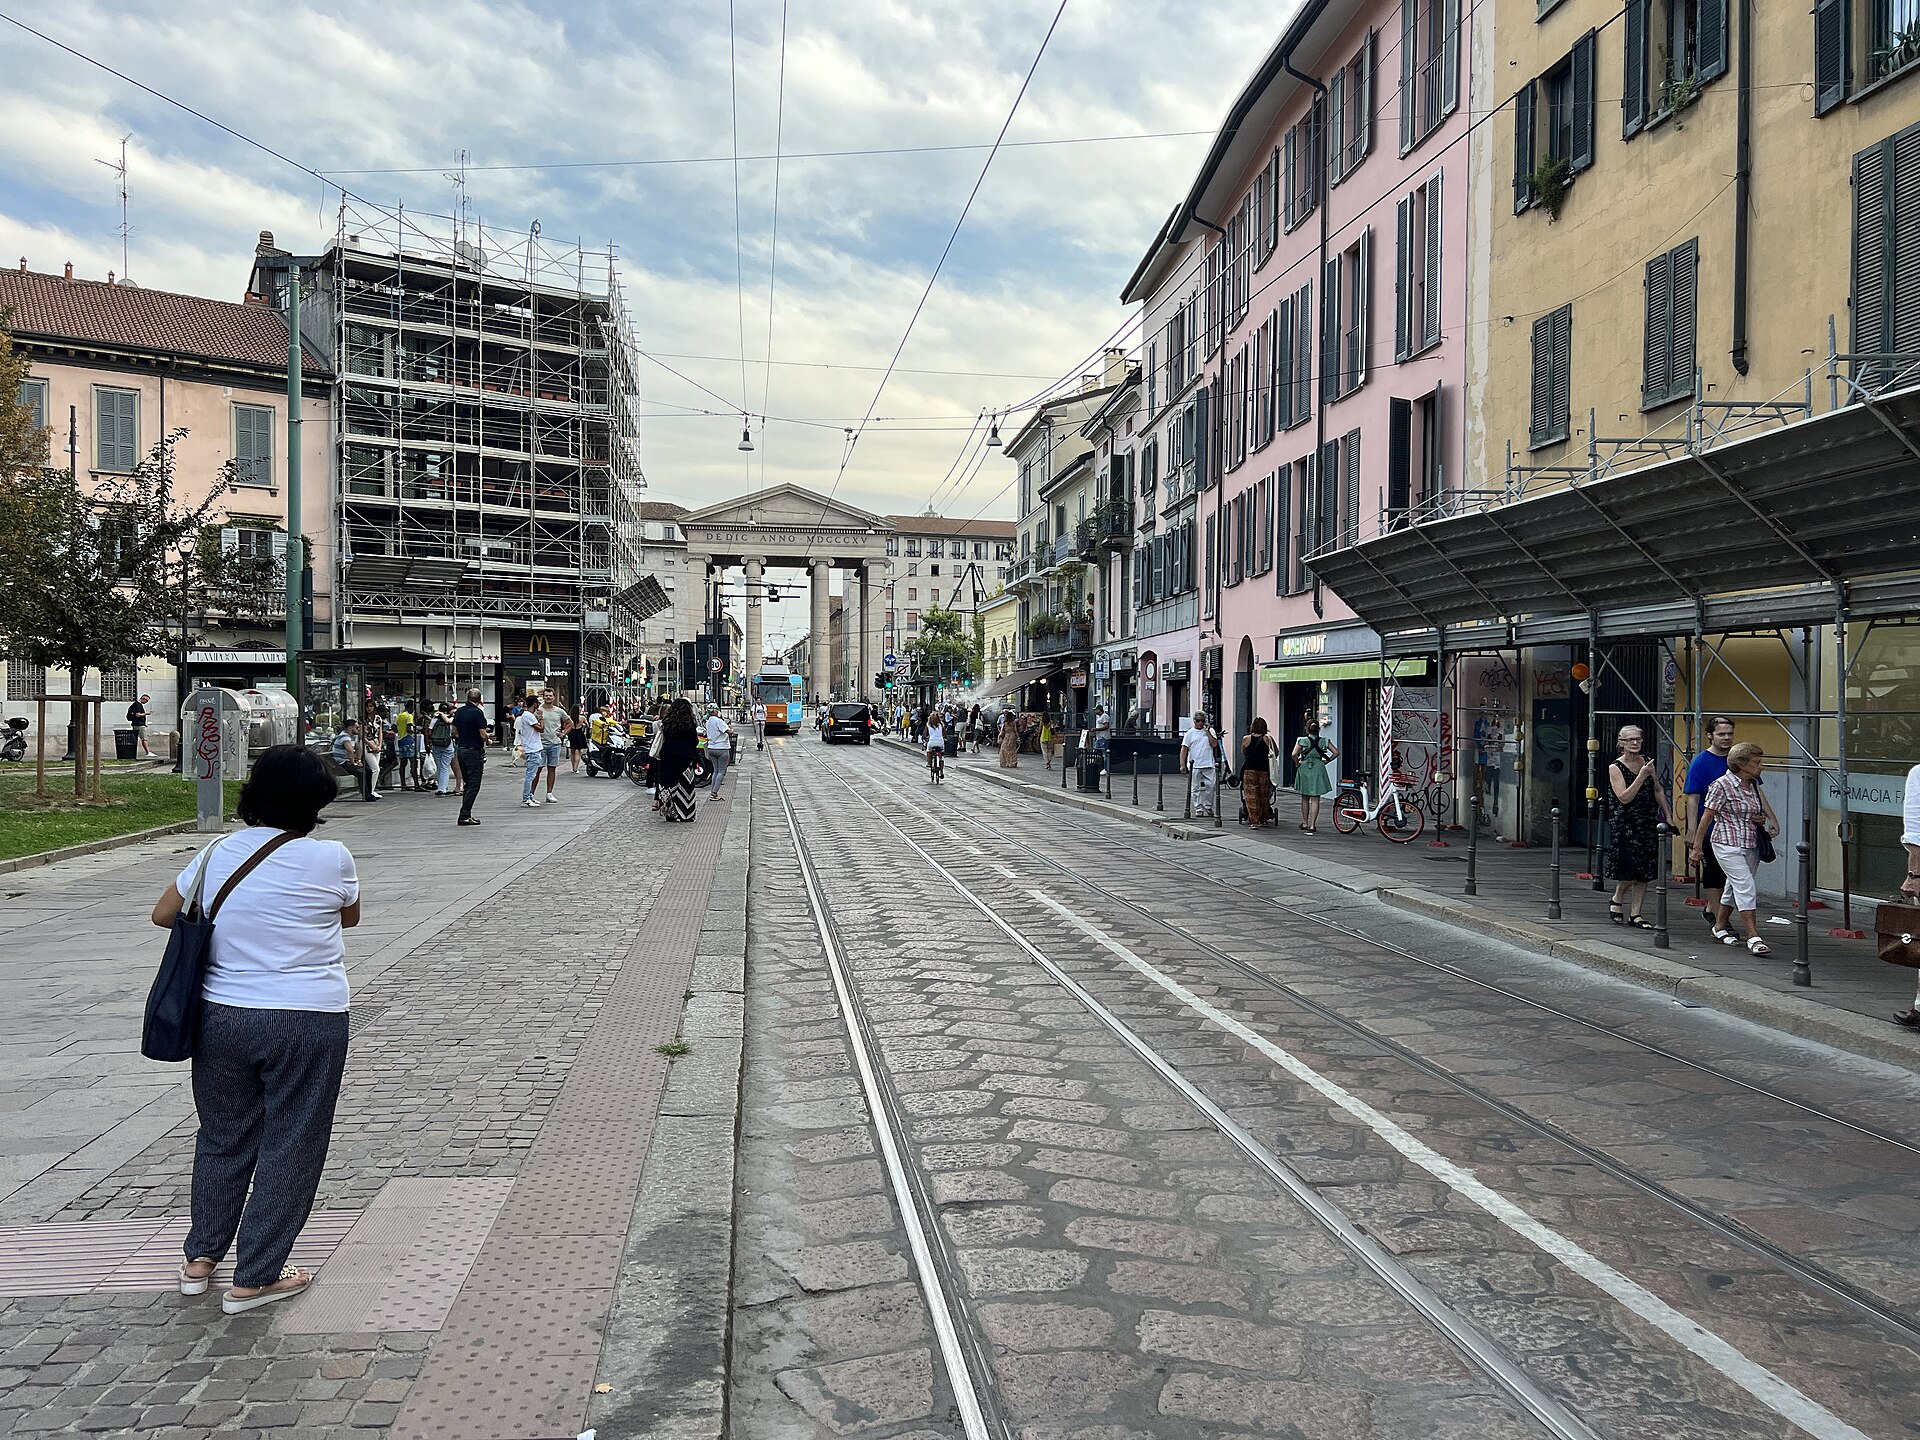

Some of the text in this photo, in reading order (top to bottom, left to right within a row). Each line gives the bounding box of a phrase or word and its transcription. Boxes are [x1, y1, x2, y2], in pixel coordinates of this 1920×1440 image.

[706, 532, 868, 544] DEDIC ANNO MDCCCXV
